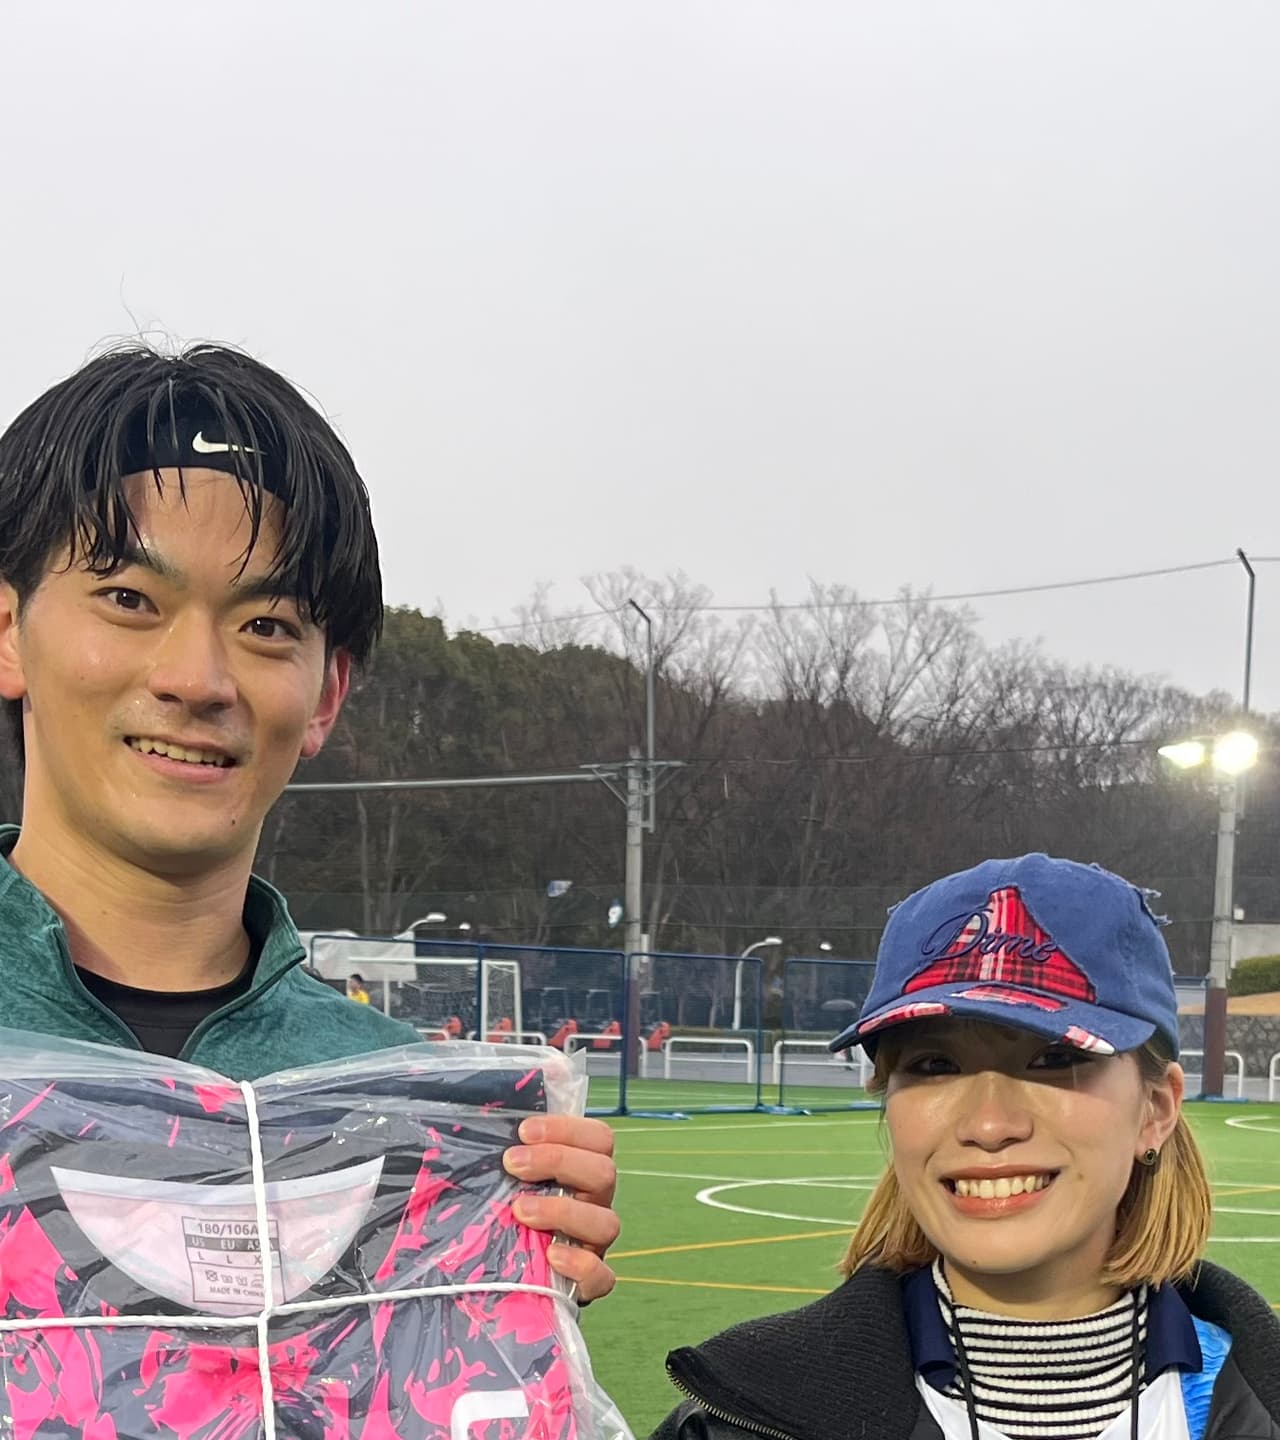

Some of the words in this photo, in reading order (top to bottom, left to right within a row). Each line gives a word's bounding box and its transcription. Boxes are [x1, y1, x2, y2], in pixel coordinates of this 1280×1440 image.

[921, 908, 1057, 962] Dime
[192, 1236, 205, 1247] US
[221, 1239, 235, 1250] EU
[226, 1254, 232, 1264] L
[209, 1286, 230, 1295] MADE
